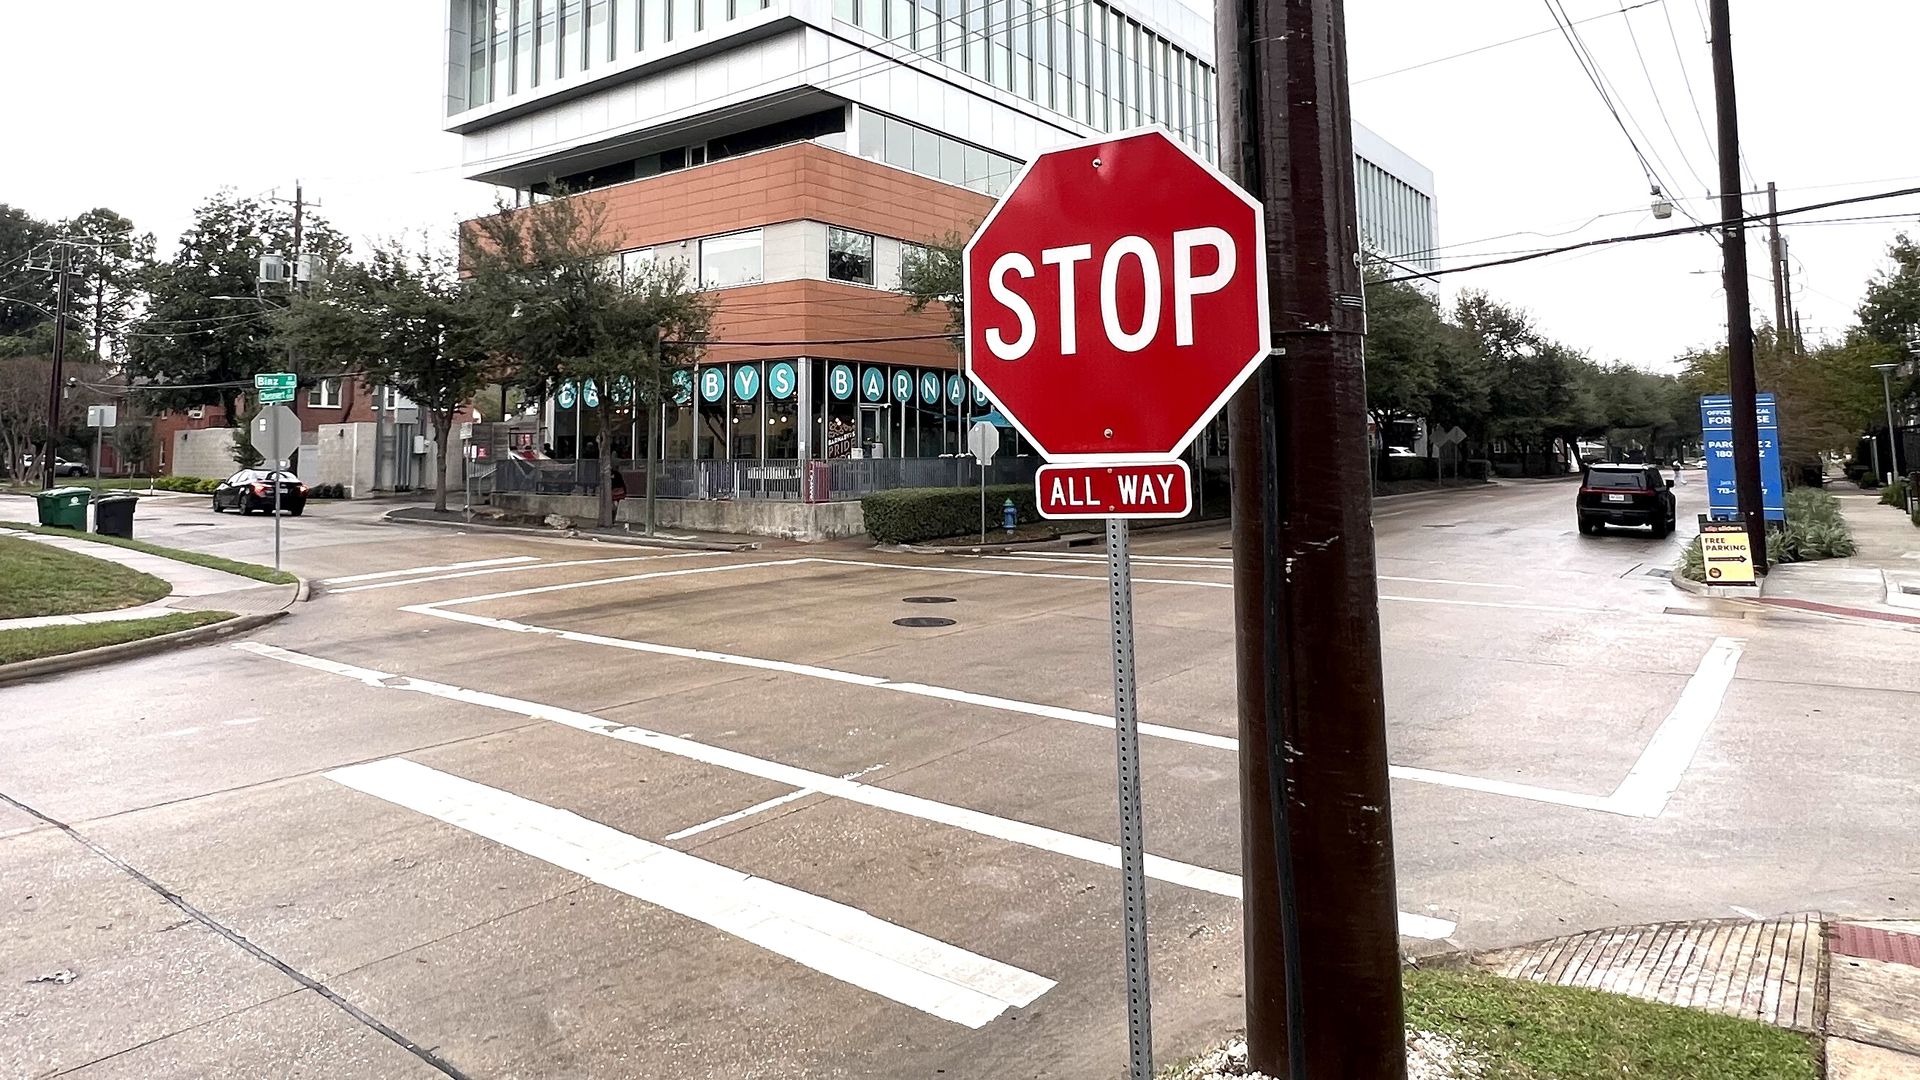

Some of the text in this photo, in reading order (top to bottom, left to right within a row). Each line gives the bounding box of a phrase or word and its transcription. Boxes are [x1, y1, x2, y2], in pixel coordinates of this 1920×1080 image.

[985, 226, 1237, 361] STOP
[257, 377, 279, 386] Binz
[1708, 416, 1732, 424] FOR
[828, 437, 857, 458] PRIDE
[1715, 450, 1732, 458] 180
[1050, 473, 1175, 507] ALL WAY
